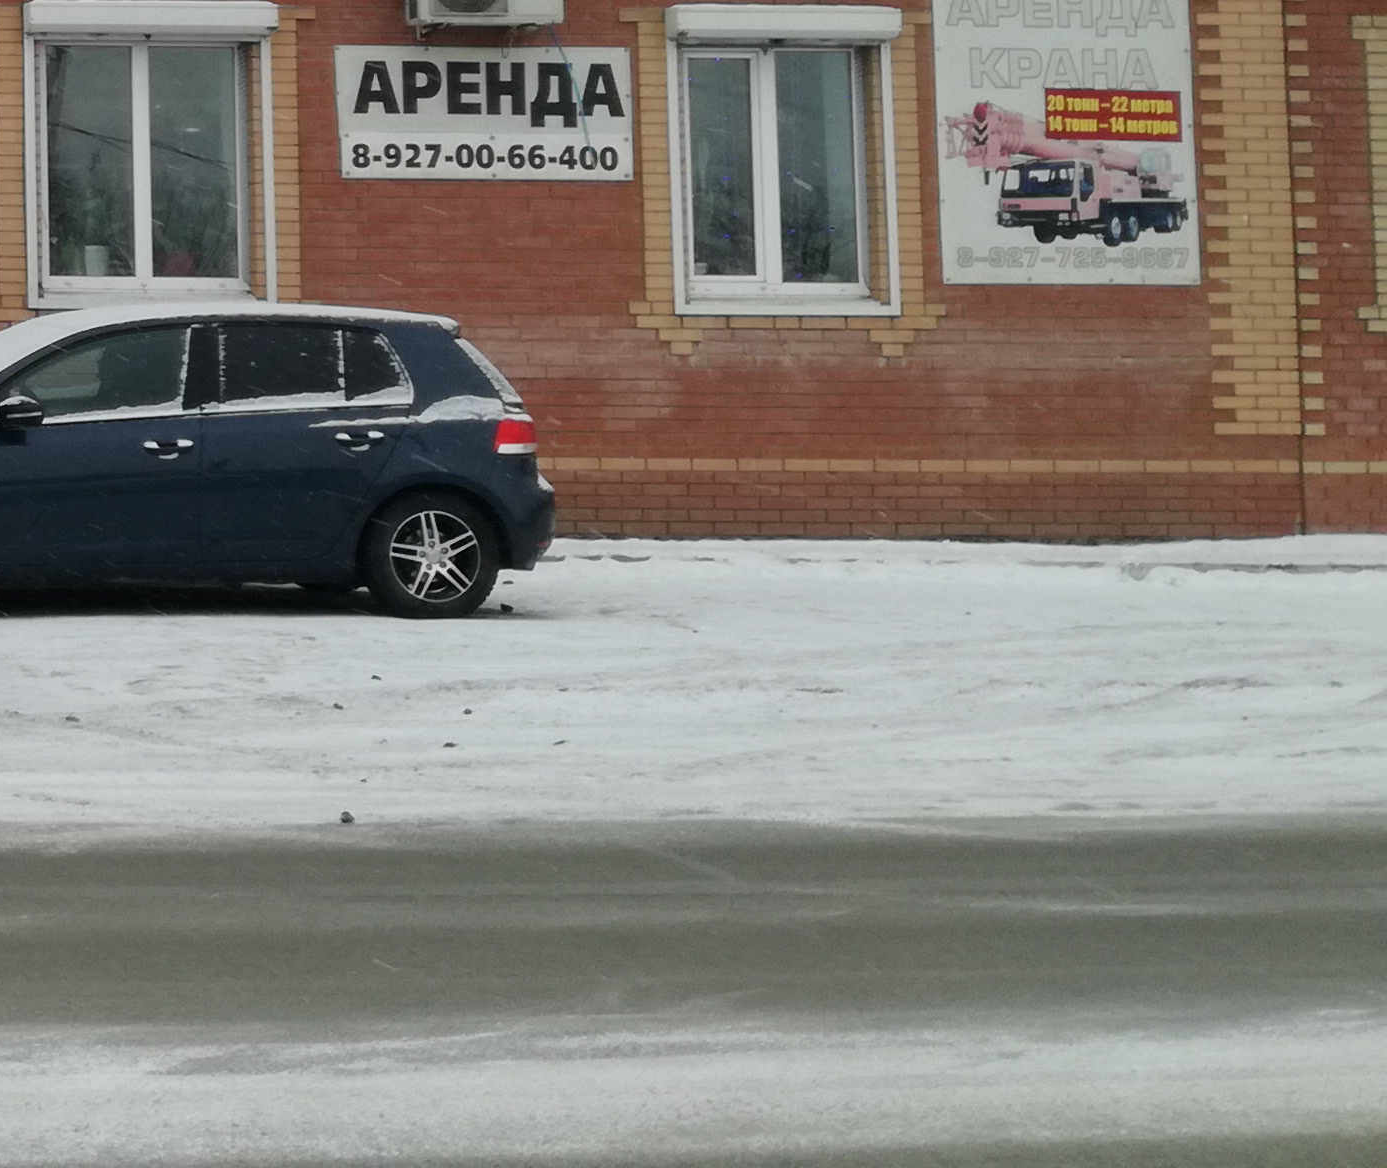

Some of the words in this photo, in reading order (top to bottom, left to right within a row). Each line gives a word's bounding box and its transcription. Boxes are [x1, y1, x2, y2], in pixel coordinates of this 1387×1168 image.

[968, 47, 1159, 90] КРАНА
[353, 60, 625, 128] АРЕНДА
[1047, 94, 1065, 112] 20
[1066, 98, 1099, 112] тонн
[1111, 96, 1129, 112] 22
[1048, 115, 1063, 131] 14
[1064, 118, 1098, 132] тонн
[1109, 116, 1125, 133] 14
[351, 143, 619, 171] 8-927-00-66-400
[956, 246, 1190, 269] 8-927-725-9667
